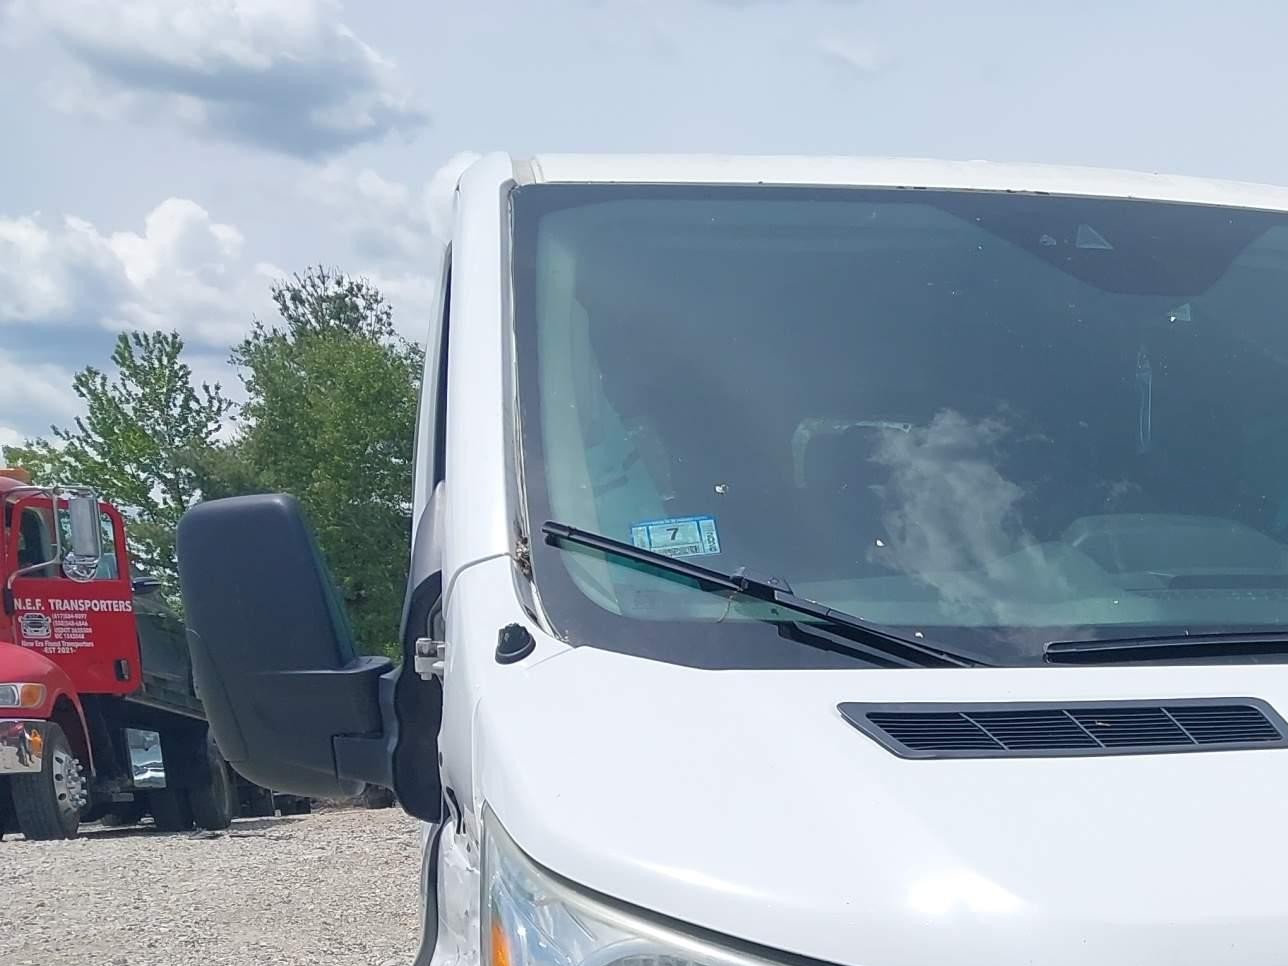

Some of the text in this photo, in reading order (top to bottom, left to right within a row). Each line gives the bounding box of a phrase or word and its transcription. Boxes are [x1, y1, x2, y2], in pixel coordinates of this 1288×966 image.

[666, 527, 679, 541] 7
[14, 598, 132, 612] N.E.F. TRANSPORTERS
